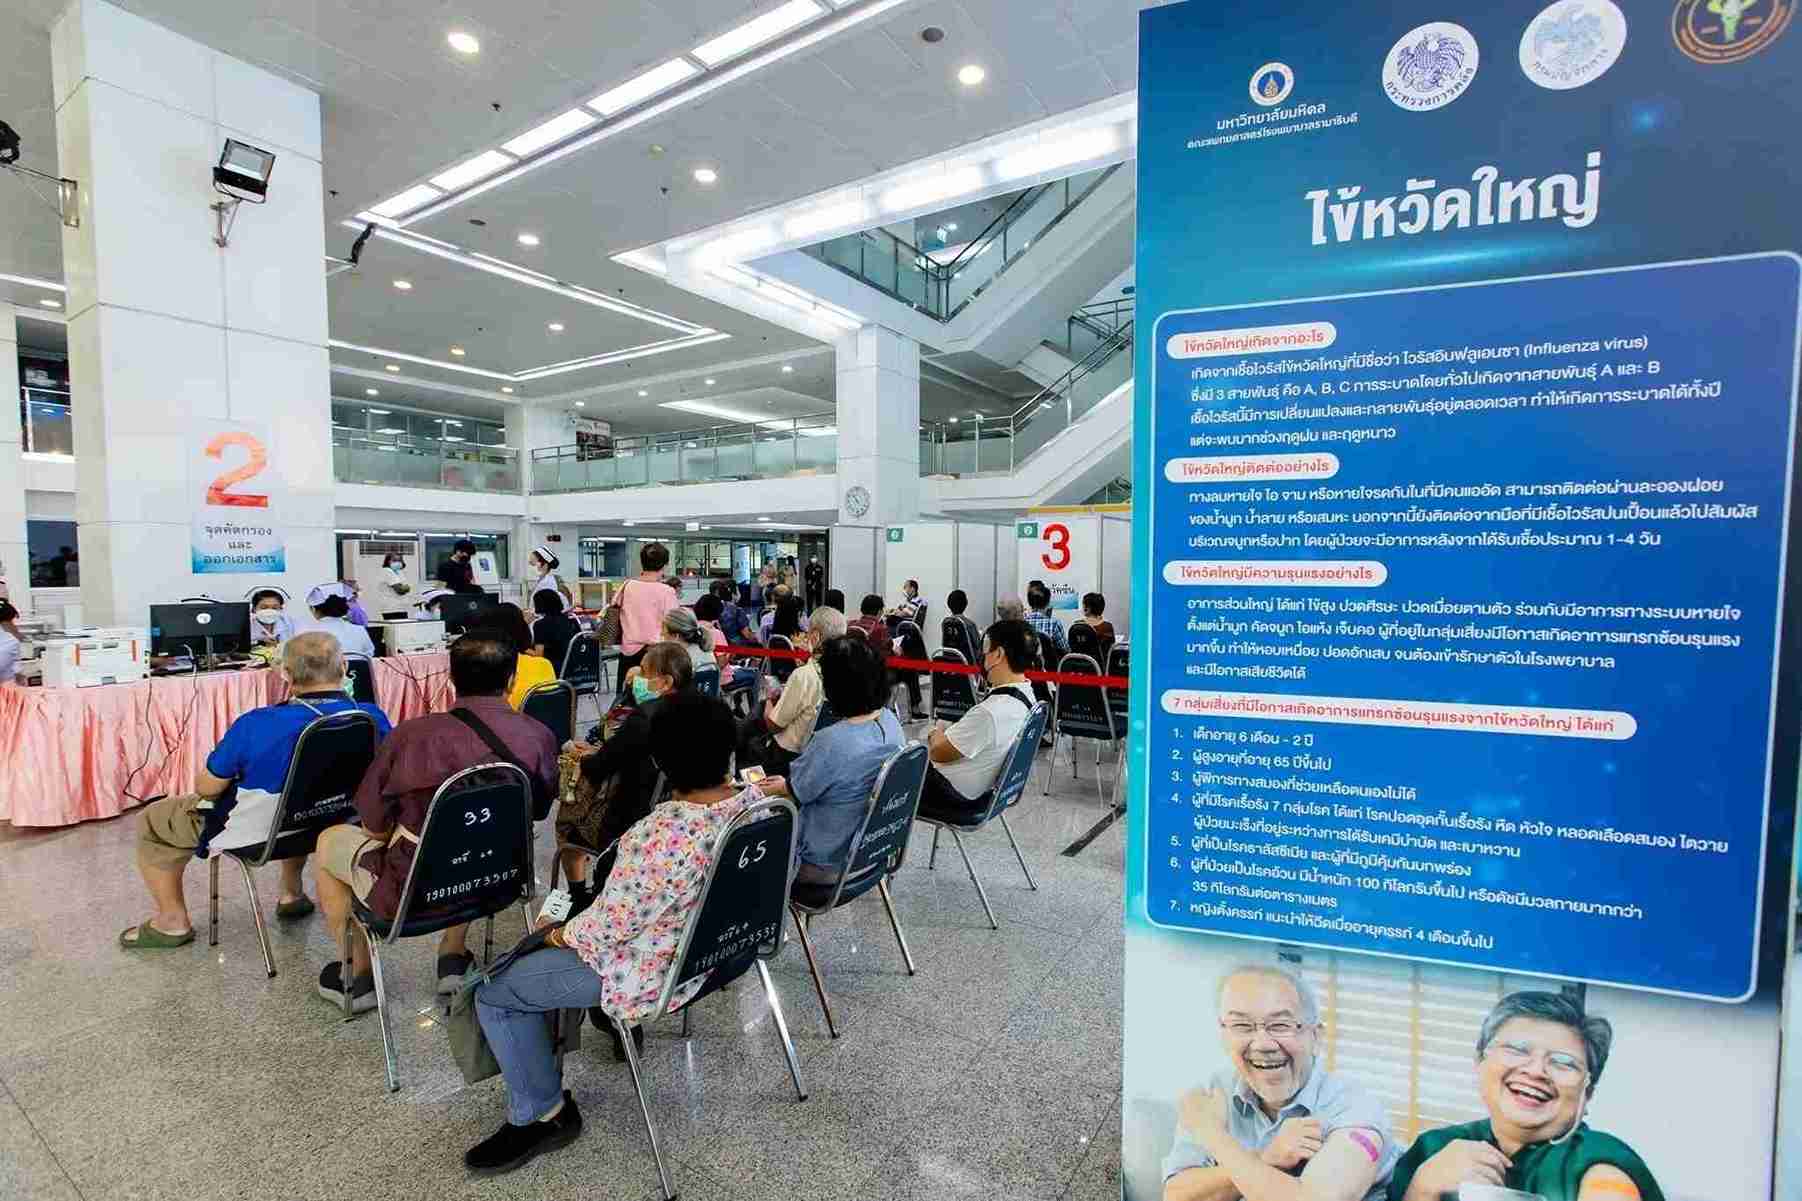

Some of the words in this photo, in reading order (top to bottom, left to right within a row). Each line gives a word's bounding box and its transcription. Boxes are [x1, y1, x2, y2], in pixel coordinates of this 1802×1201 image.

[1216, 102, 1327, 130] มหาวิทยาลัยมหิดล
[1304, 151, 1601, 246] ไข้หวัดใหญ่
[1184, 330, 1325, 354] ไข้หวัดใหญ่เกิดจากอะไร
[1523, 339, 1600, 358] (Influenza
[1603, 335, 1649, 351] virus)
[1216, 389, 1225, 400] 3
[1600, 365, 1613, 378] A
[1617, 363, 1643, 377] และ
[1648, 361, 1660, 375] B
[205, 431, 269, 508] 2
[1183, 460, 1330, 476] ไข้หวัดใหญ่ติดต่ออย่างไร
[1042, 522, 1072, 571] 3
[1639, 532, 1661, 546] วัน
[1180, 565, 1373, 583] ไข้หวัดใหญ่มีความรุนแรงอย่างไร
[1402, 593, 1511, 614] ปวดเมื่อยตามตัว
[1515, 600, 1741, 621] ร่วมกับมีอาการทางระบบหายใจ
[1173, 697, 1181, 708] 7
[1575, 717, 1615, 732] ได้แก่
[1239, 732, 1248, 742] 6
[1273, 757, 1290, 768] 65
[1273, 801, 1281, 812] 7
[738, 840, 768, 869] 65
[1192, 881, 1208, 892] 35
[1354, 877, 1380, 890] 100
[1415, 930, 1425, 942] 4
